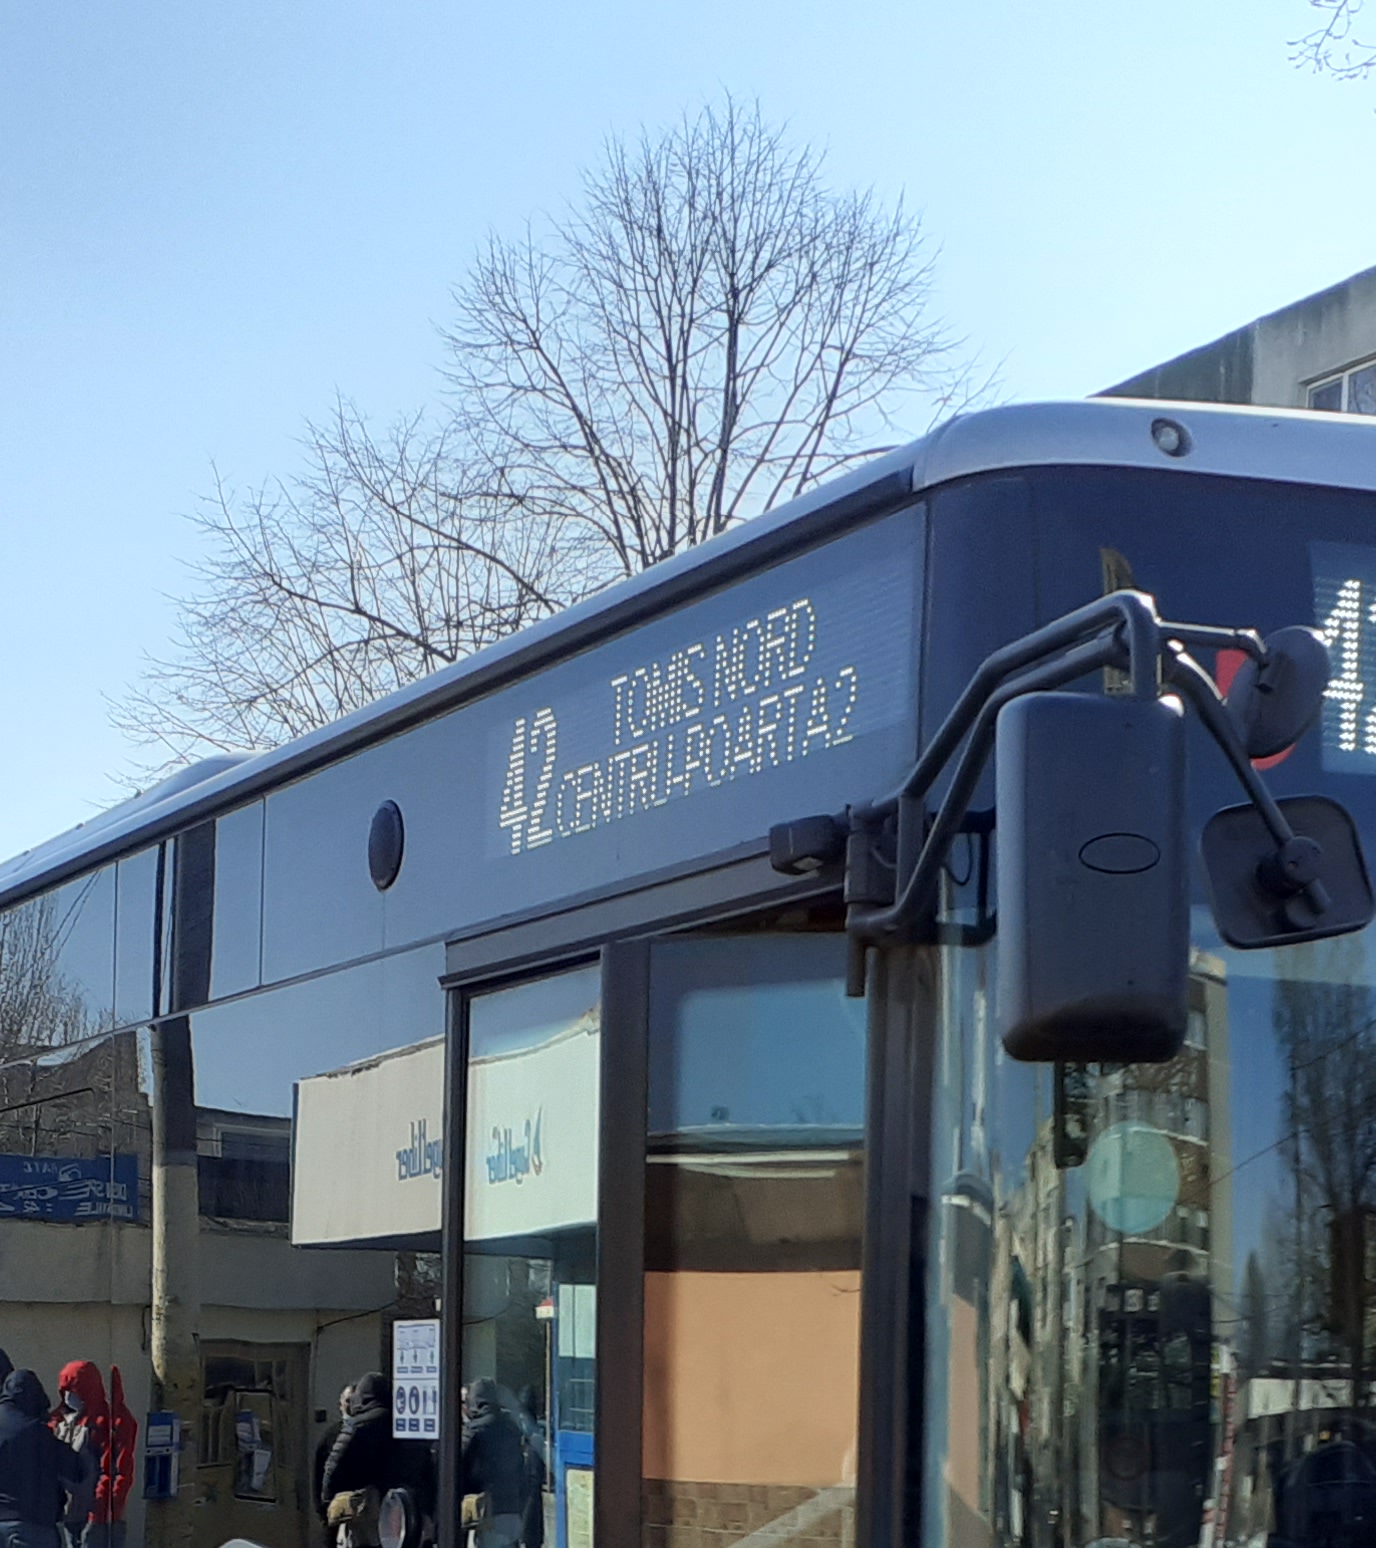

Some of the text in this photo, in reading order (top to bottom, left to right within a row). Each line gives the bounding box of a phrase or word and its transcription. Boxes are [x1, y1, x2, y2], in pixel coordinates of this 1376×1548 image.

[610, 598, 817, 745] TOMIS NORD
[498, 706, 559, 856] 42
